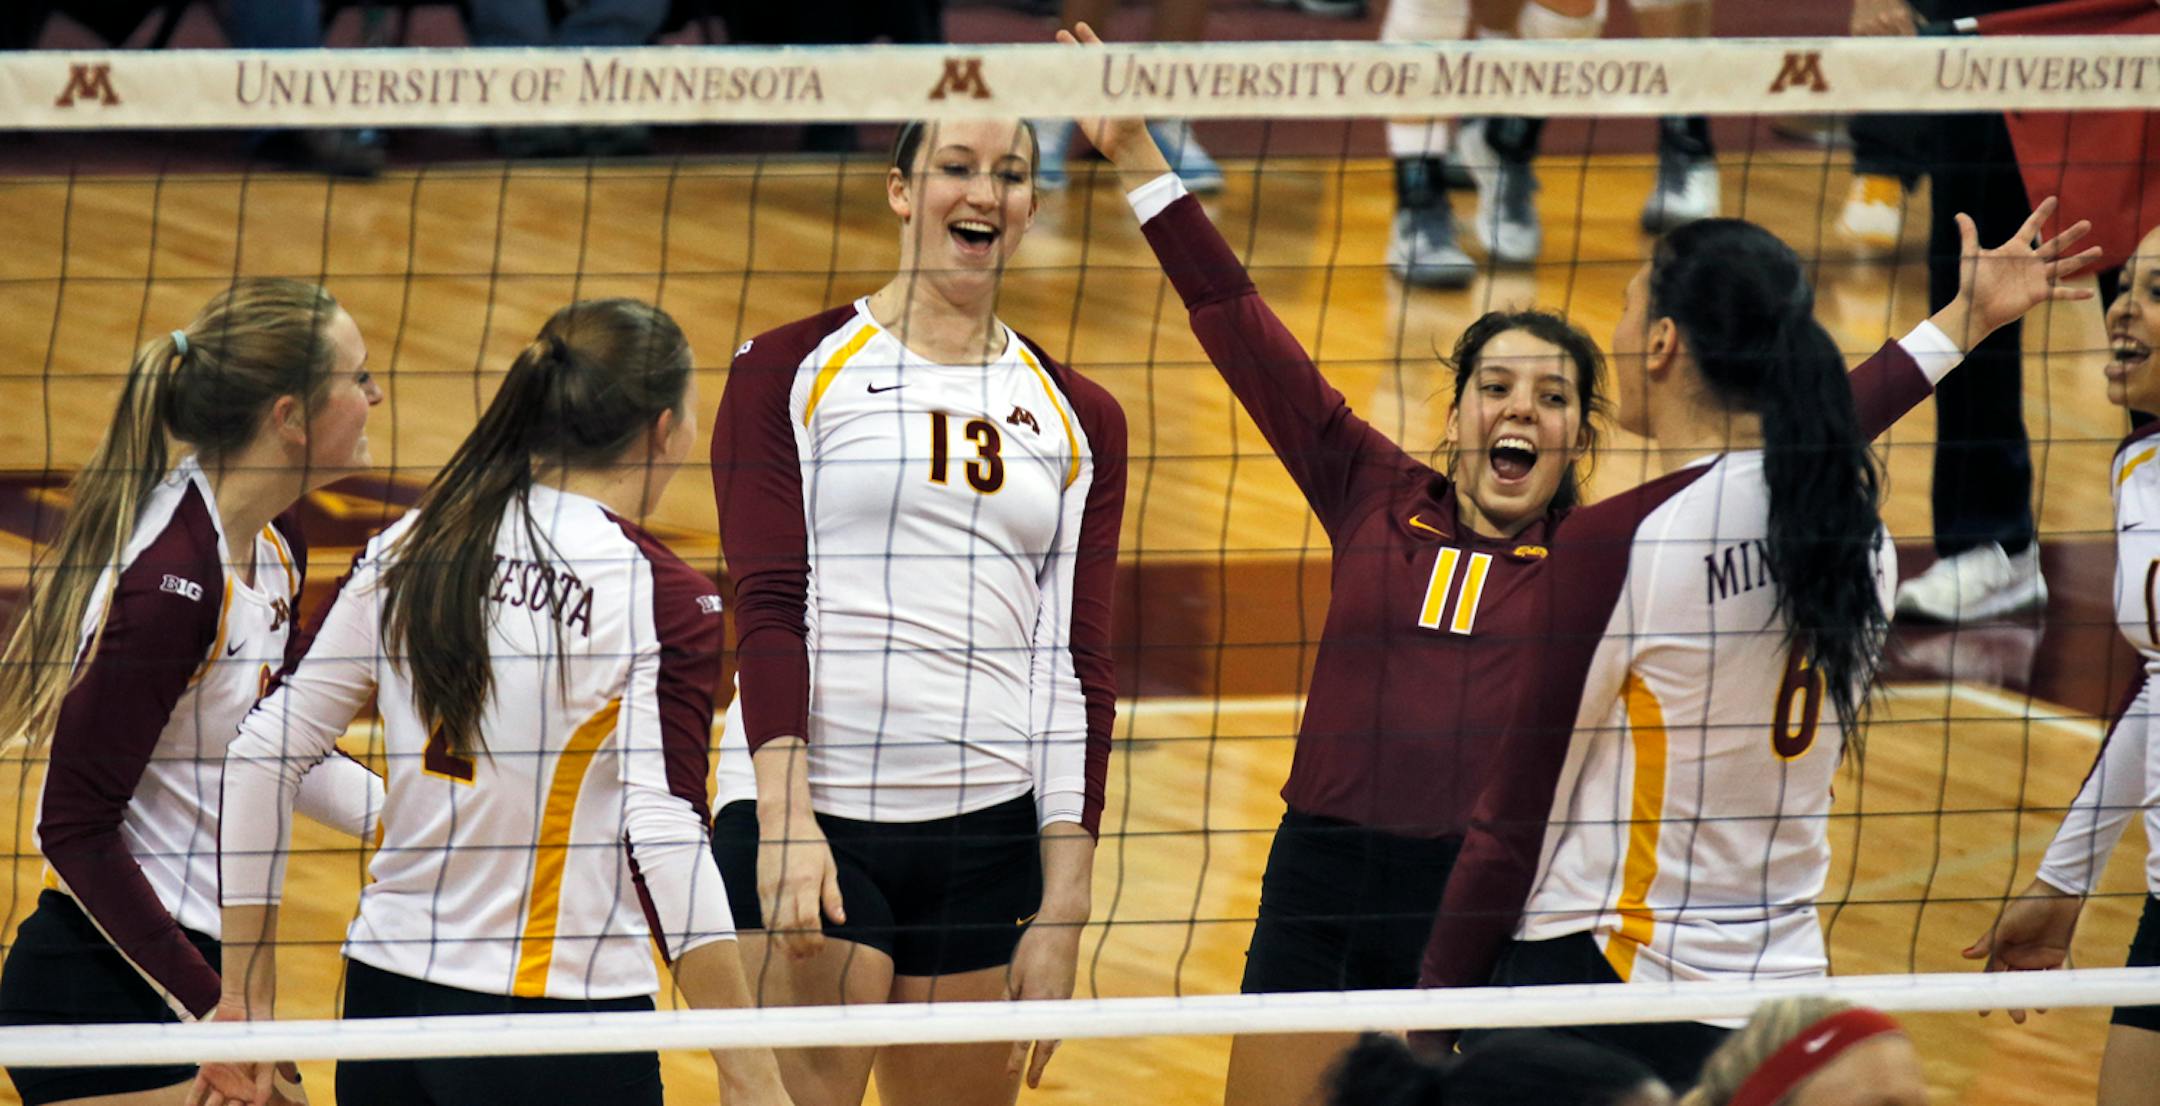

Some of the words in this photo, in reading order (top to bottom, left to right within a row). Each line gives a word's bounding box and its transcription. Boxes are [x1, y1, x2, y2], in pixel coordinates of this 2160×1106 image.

[236, 60, 498, 105] UNIVERSITY
[511, 67, 565, 102] OF
[579, 57, 824, 103] MINNESOTA
[1101, 53, 1354, 98] UNIVERSITY
[1366, 61, 1420, 96] OF
[1432, 52, 1670, 96] MINNESOTA
[1936, 48, 2160, 91] UNIVERSIT
[928, 409, 1006, 496] 13
[1418, 546, 1493, 635] 11
[1770, 632, 1827, 762] 6
